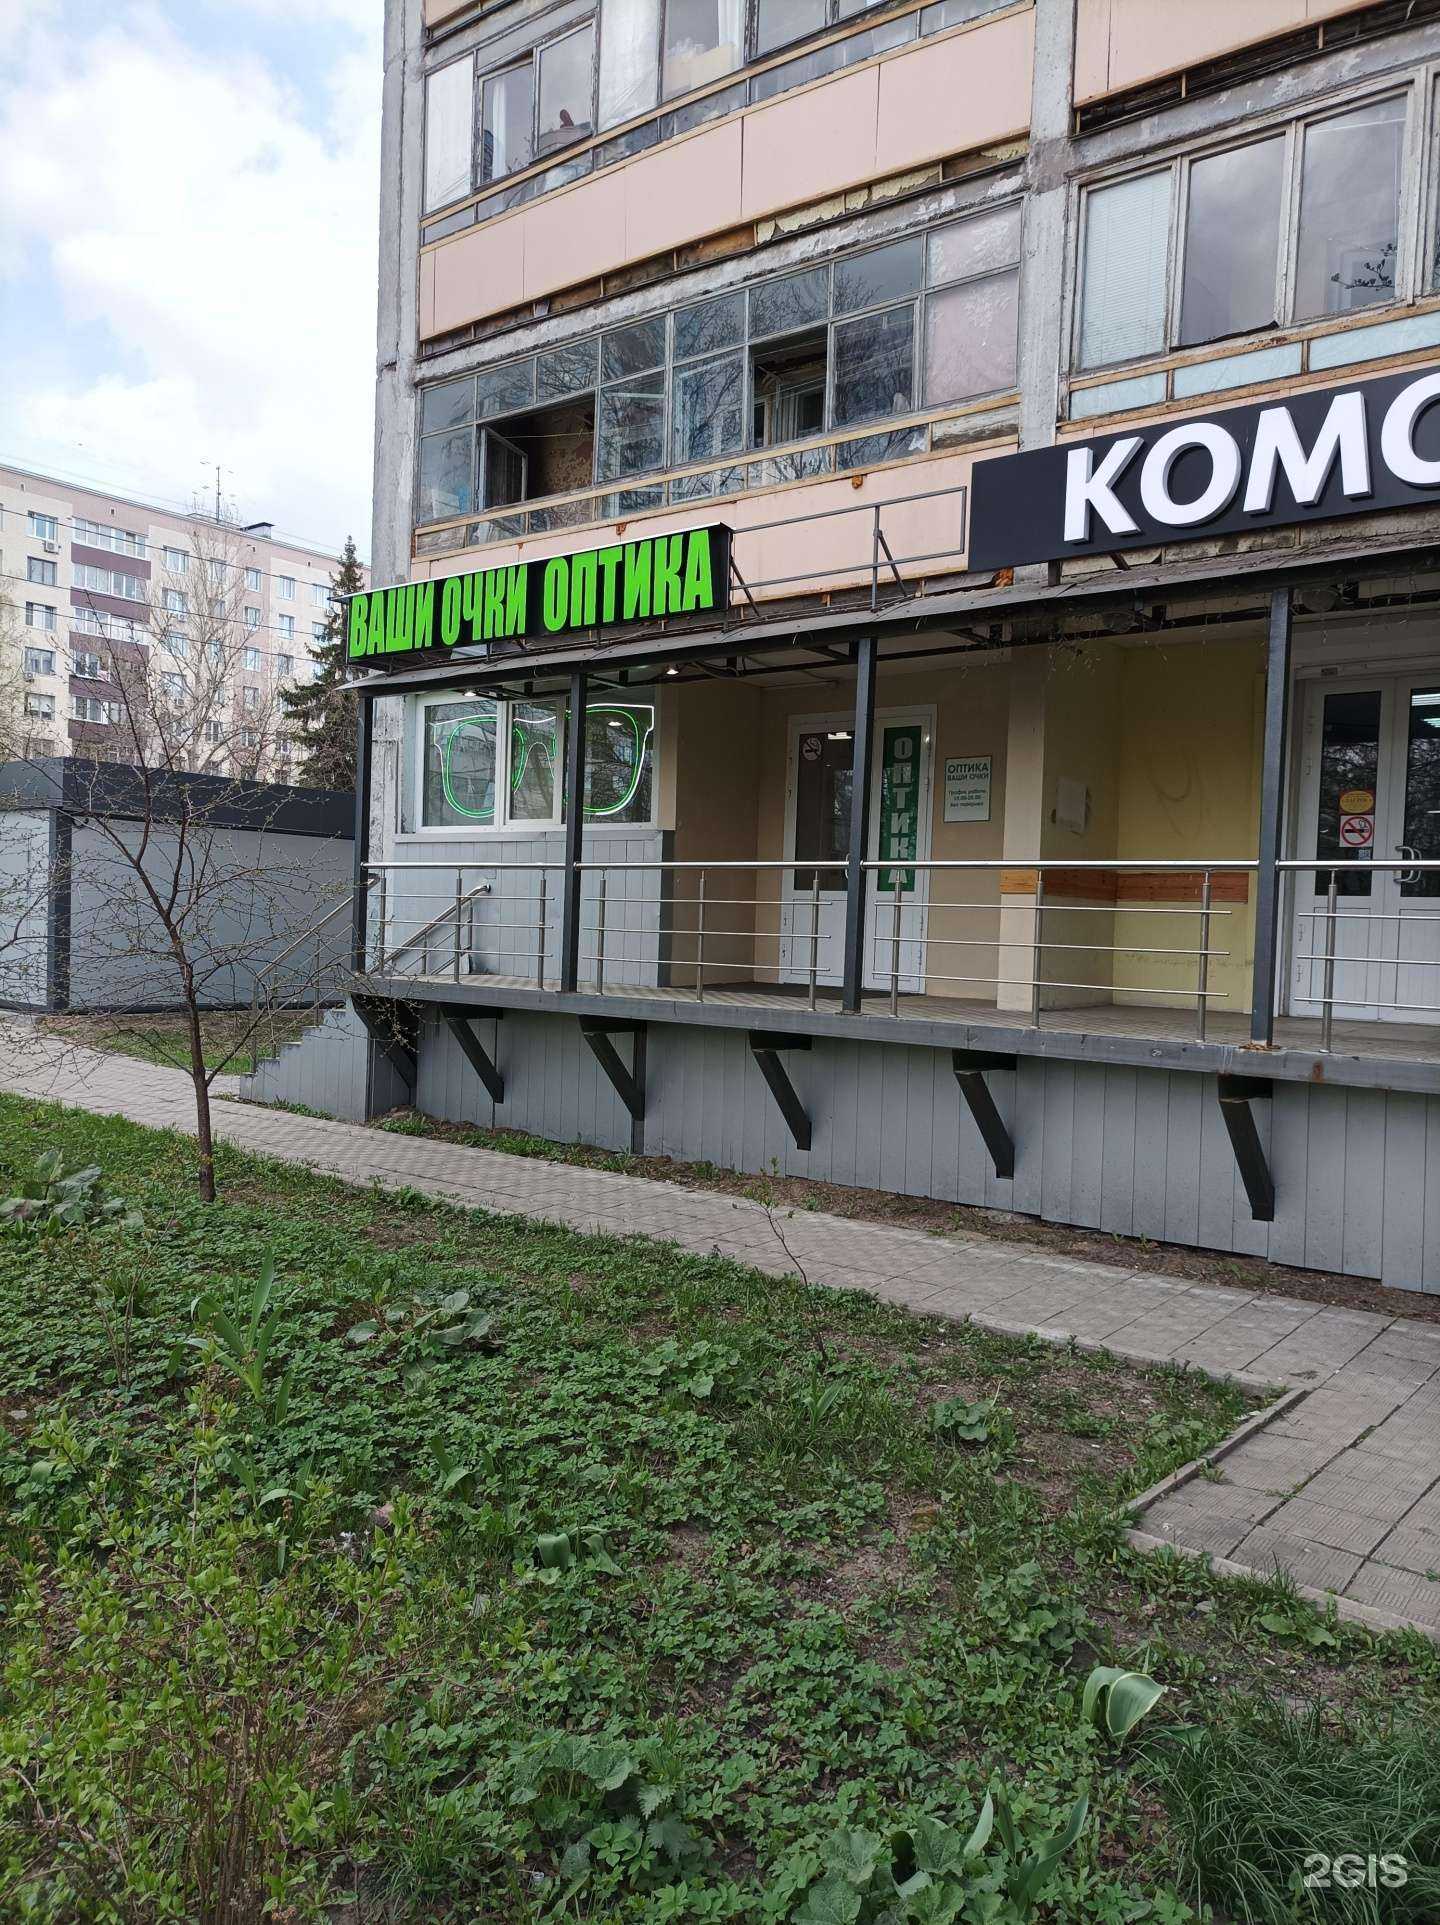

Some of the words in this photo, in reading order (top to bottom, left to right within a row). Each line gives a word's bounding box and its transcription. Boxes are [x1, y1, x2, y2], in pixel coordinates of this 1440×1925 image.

[349, 581, 435, 658] ВАШИ
[441, 564, 528, 646] ОЧКИ
[543, 529, 714, 632] ОПТИКА
[947, 762, 989, 774] ОПТИКА
[947, 774, 968, 782] ВАШИ
[969, 772, 989, 780] ОЧКИ
[888, 737, 914, 884] ОПТИКА
